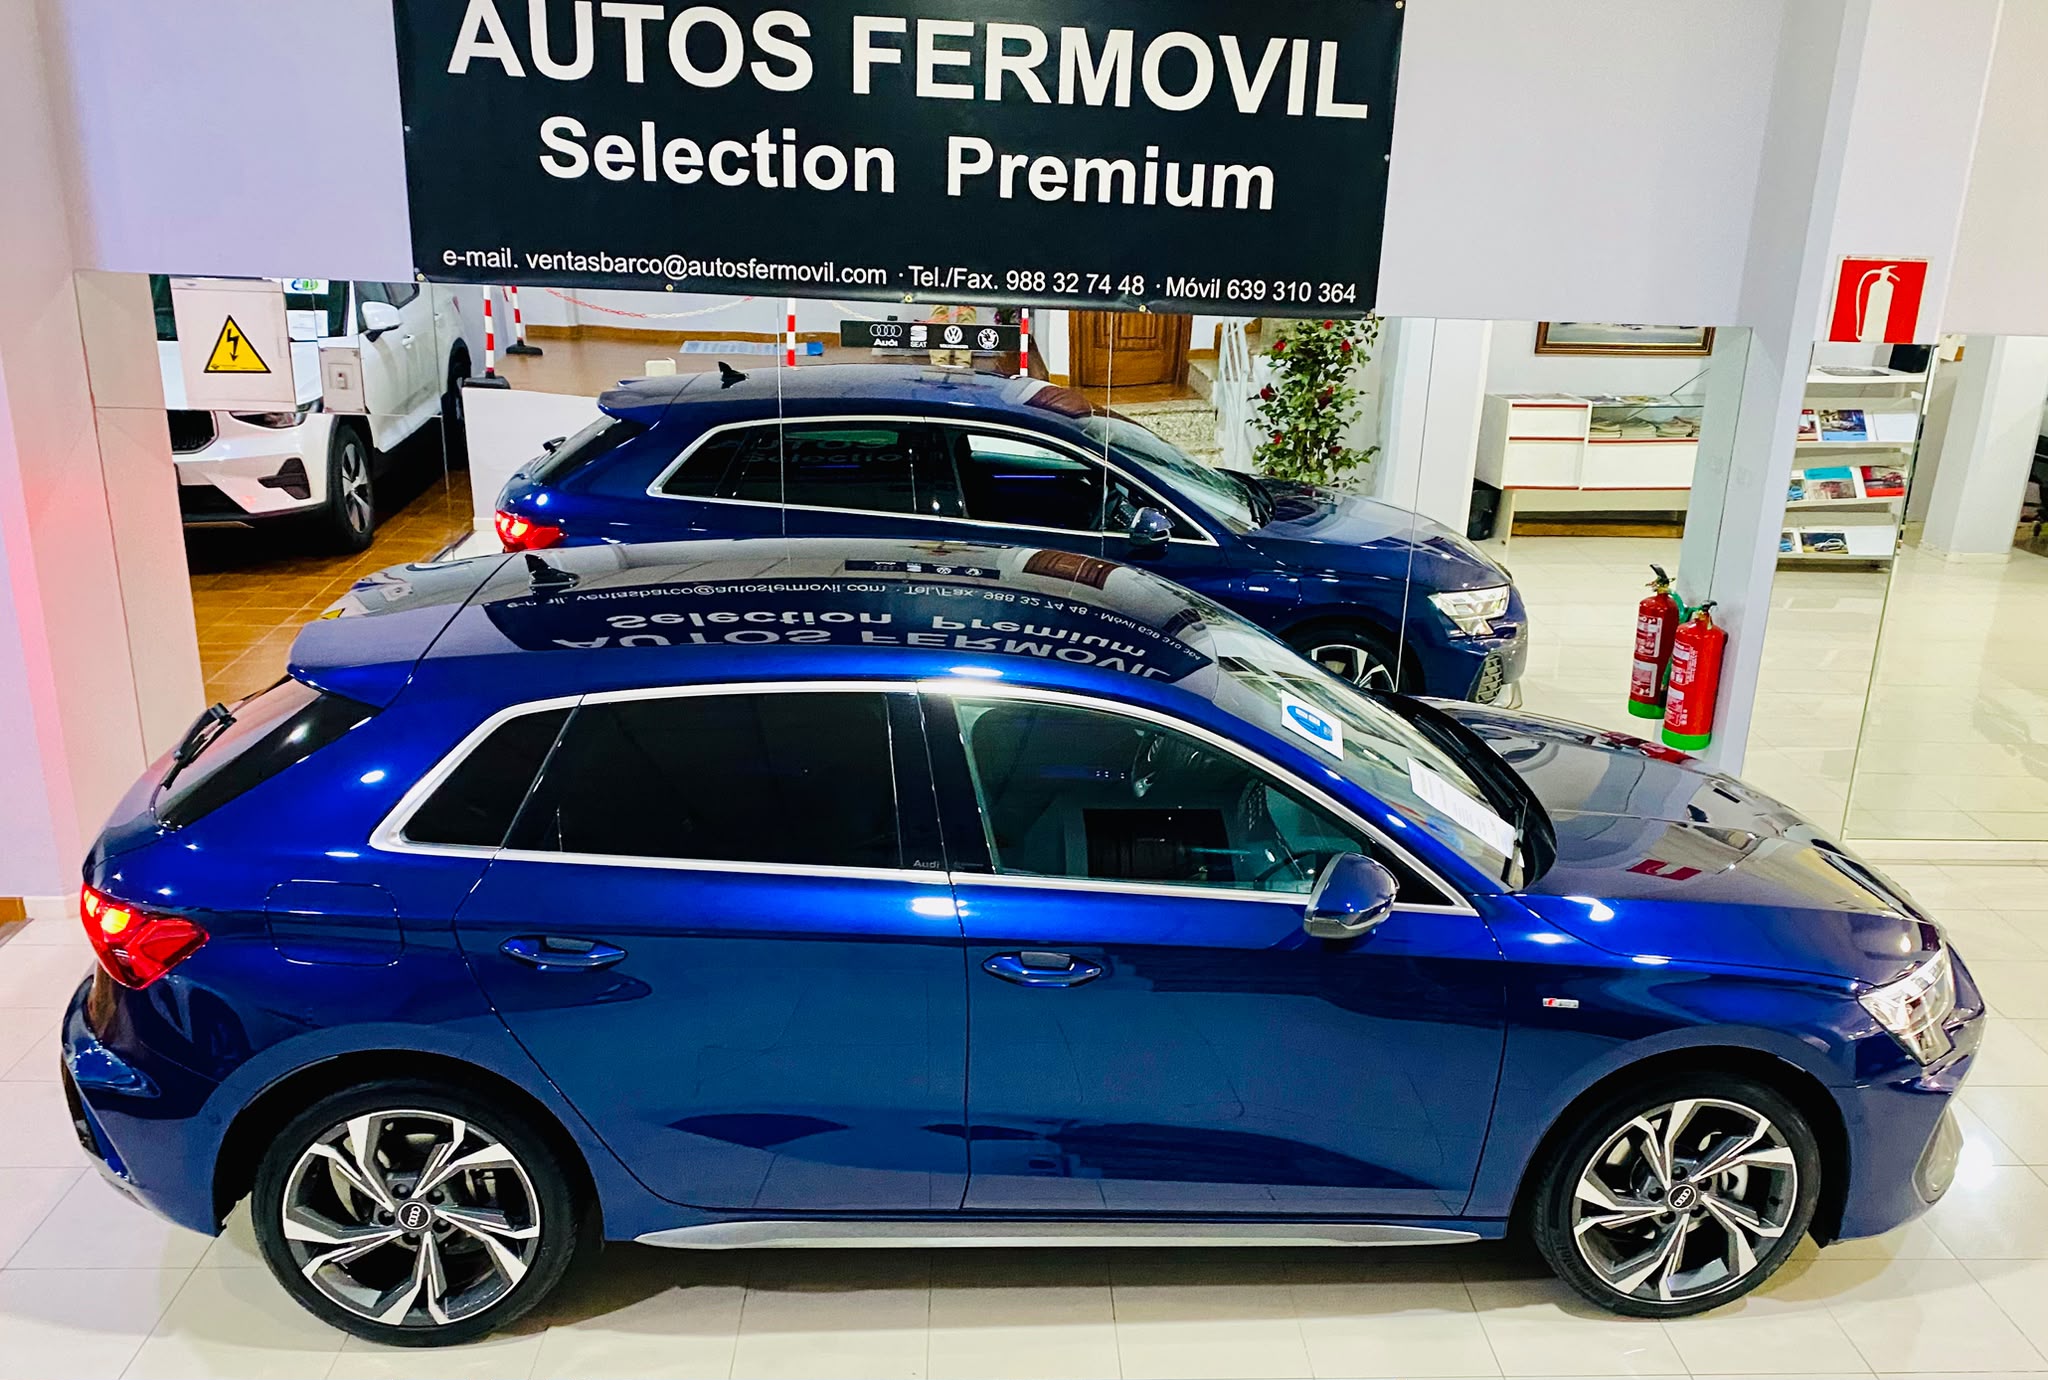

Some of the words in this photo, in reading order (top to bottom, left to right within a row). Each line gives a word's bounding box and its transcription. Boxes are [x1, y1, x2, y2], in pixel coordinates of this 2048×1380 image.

[447, 0, 814, 92] AUTOS
[852, 15, 1368, 119] FERMOVIL
[539, 115, 895, 194] Selection
[947, 135, 1274, 210] Premium
[442, 247, 519, 269] e-mail.
[526, 251, 887, 285] ventasbarco@autosfermovil.com
[1006, 269, 1046, 292] 988
[1052, 271, 1079, 293] 32
[1085, 273, 1112, 295] 74
[1118, 274, 1145, 296] 48
[1165, 276, 1221, 299] Móvil
[1226, 278, 1267, 301] 639
[1272, 280, 1312, 302] 310
[1317, 282, 1357, 304] 364
[873, 338, 899, 347] Audi
[912, 859, 940, 869] Audi
